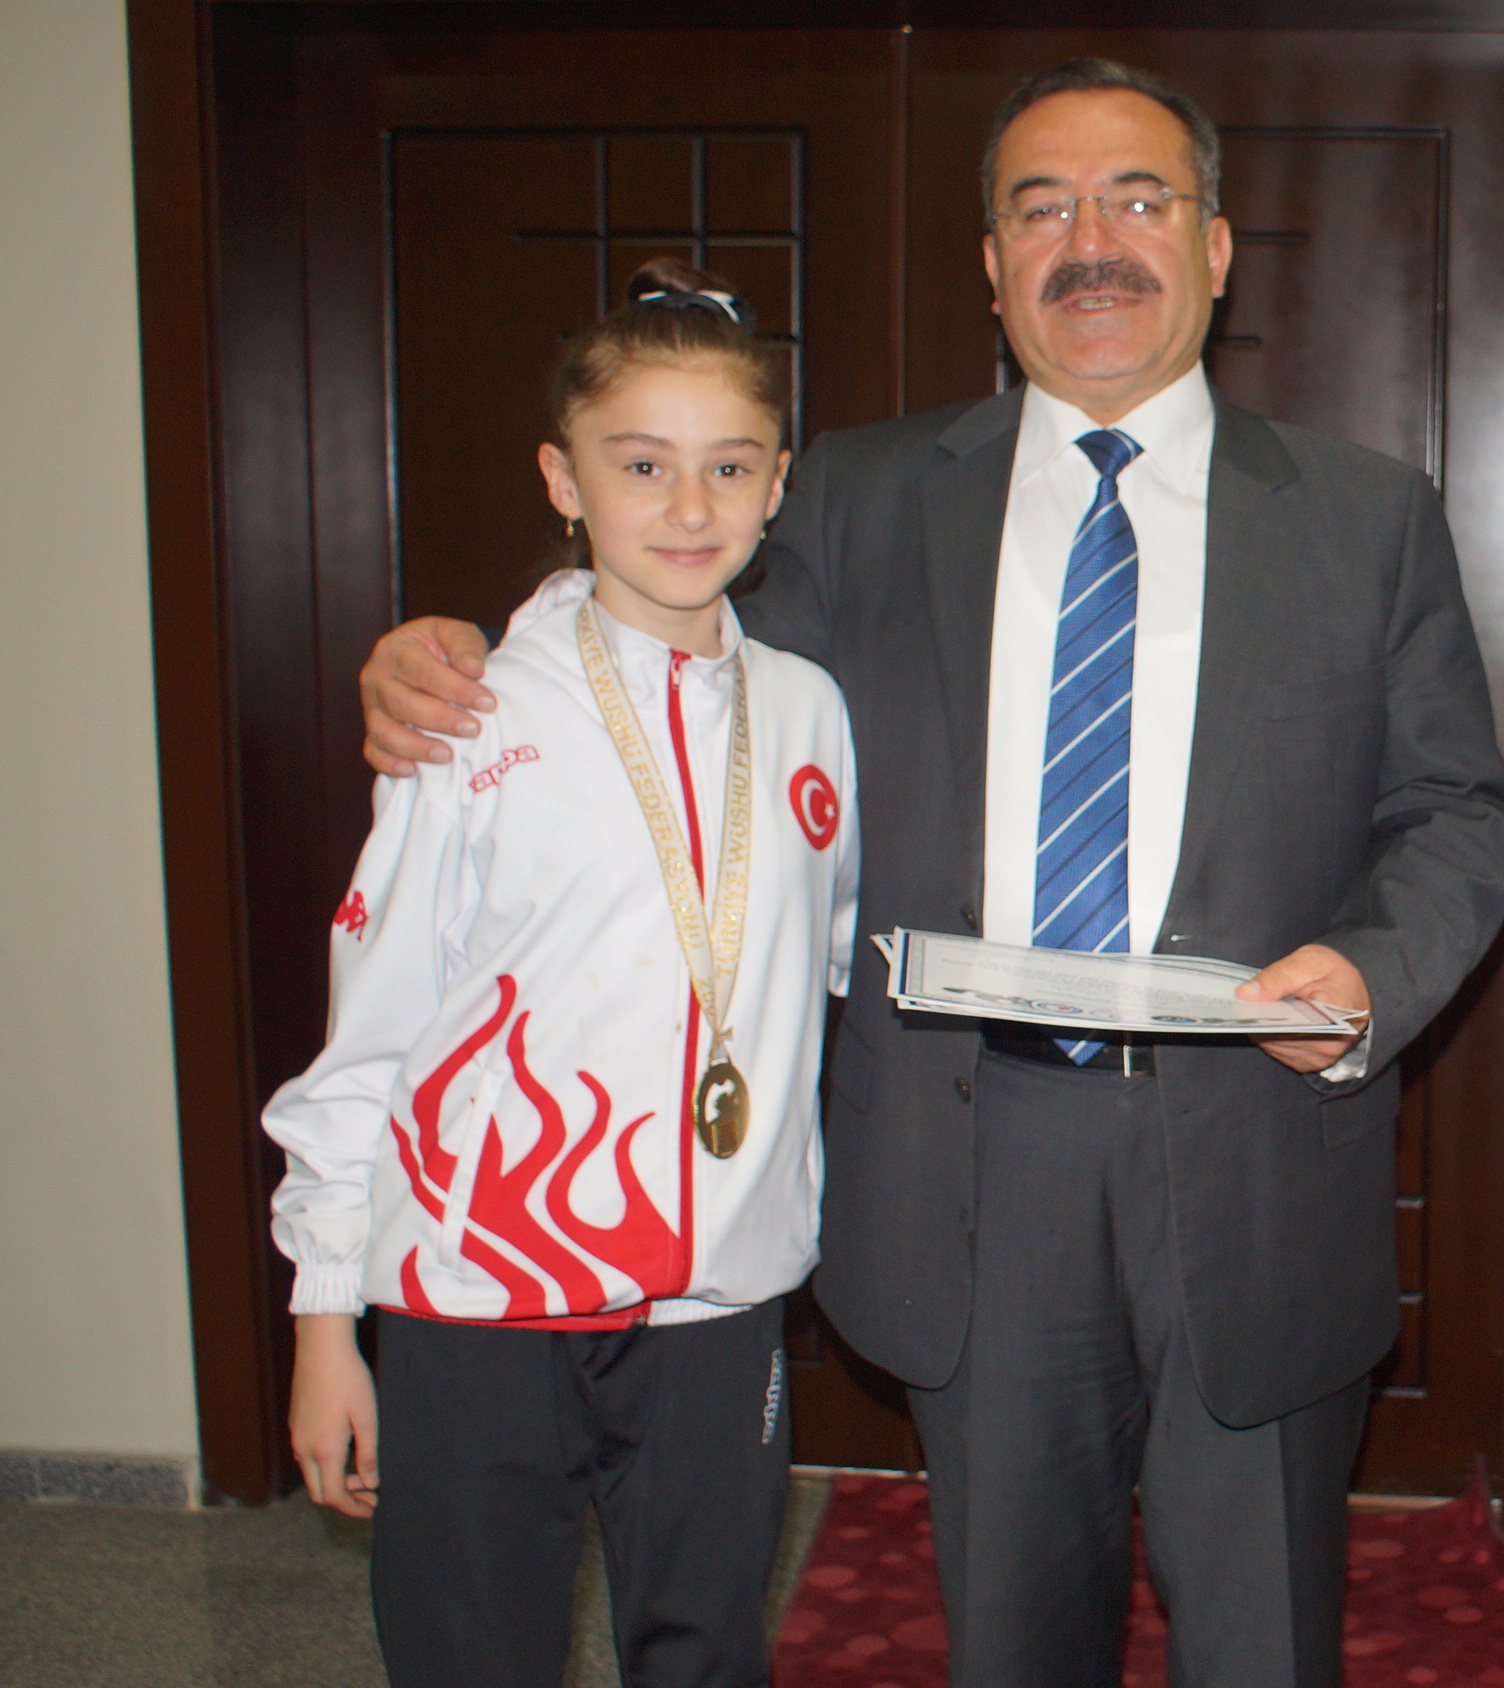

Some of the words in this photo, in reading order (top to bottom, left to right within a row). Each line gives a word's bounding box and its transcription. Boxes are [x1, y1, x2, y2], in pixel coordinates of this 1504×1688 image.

[469, 745, 540, 793] appa
[595, 672, 641, 758] WUSHU
[630, 763, 705, 948] FEDERASYONU
[728, 774, 749, 863] WUSHU
